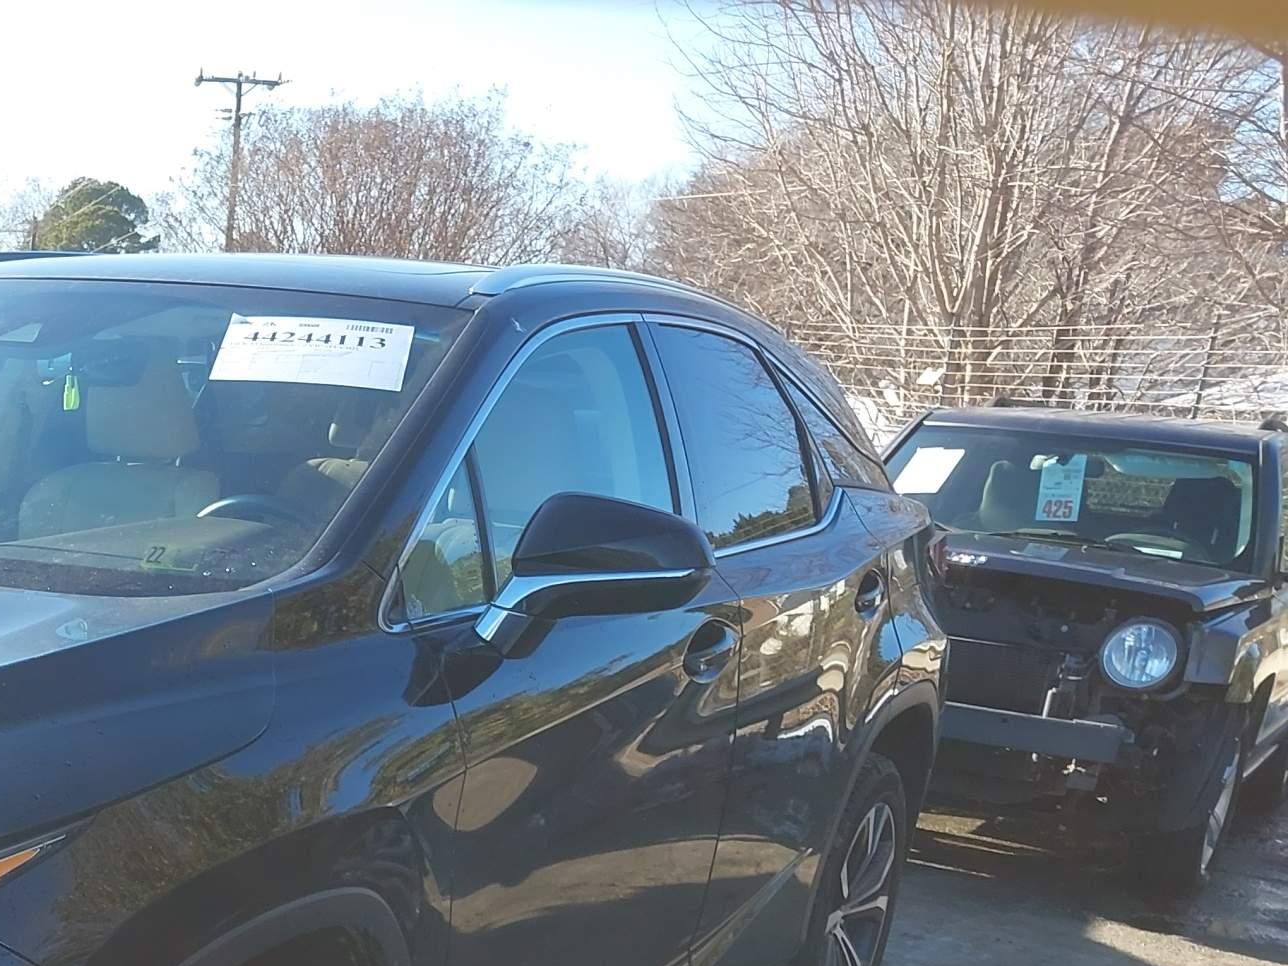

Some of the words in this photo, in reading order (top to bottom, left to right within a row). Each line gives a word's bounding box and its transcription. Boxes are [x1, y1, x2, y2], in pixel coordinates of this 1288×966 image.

[244, 331, 387, 349] 44244113
[1042, 499, 1073, 519] 425
[146, 546, 166, 564] 22
